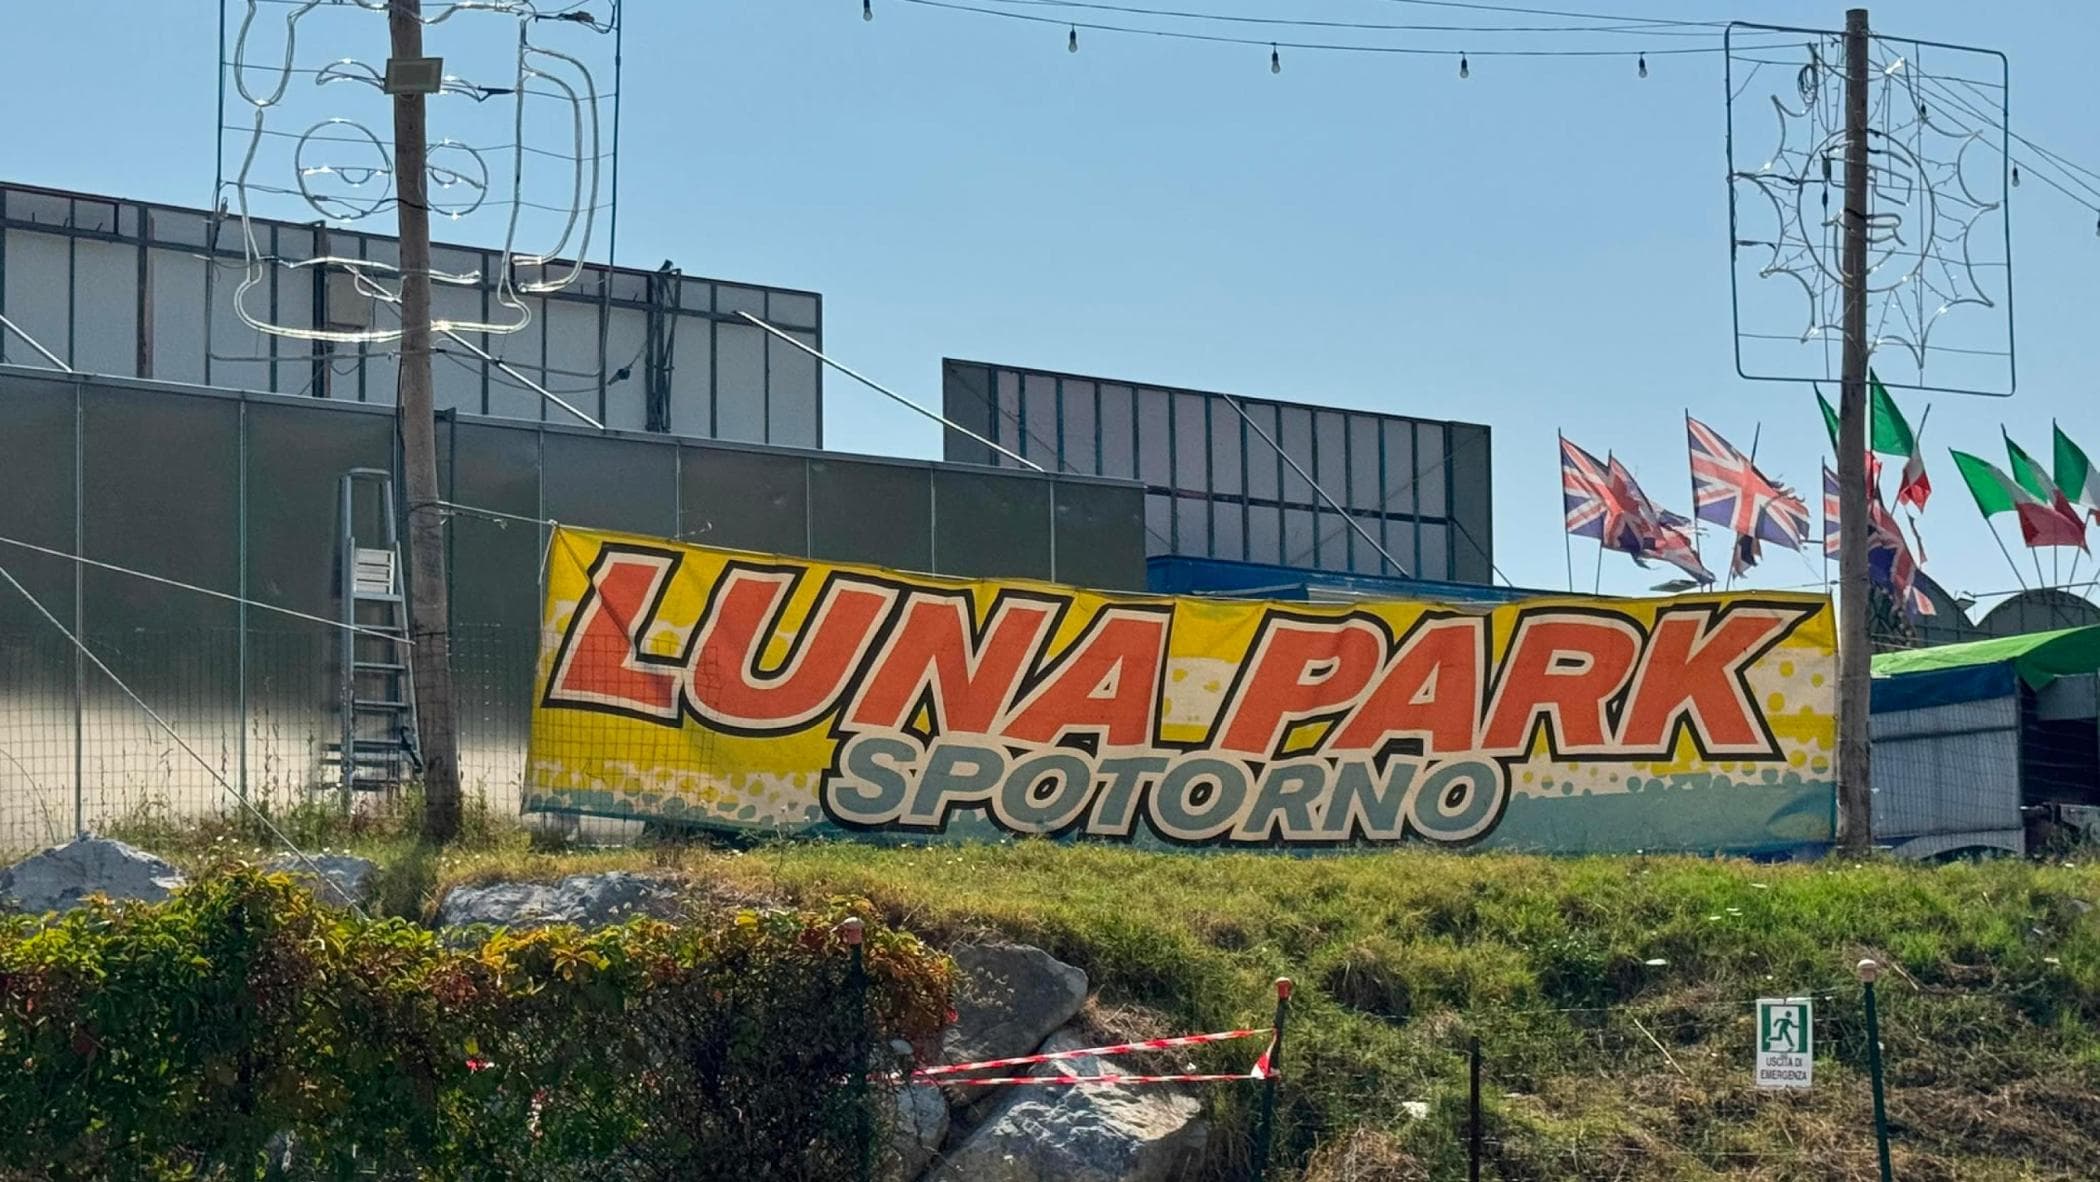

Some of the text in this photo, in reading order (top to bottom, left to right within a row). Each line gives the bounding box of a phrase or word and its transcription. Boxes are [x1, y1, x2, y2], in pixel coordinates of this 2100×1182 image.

[542, 543, 1825, 762] LUNA PARK
[819, 731, 1512, 844] SPOTORNO
[1760, 1069, 1807, 1080] EMERGENZA
[1766, 1057, 1803, 1067] USCITA DI
